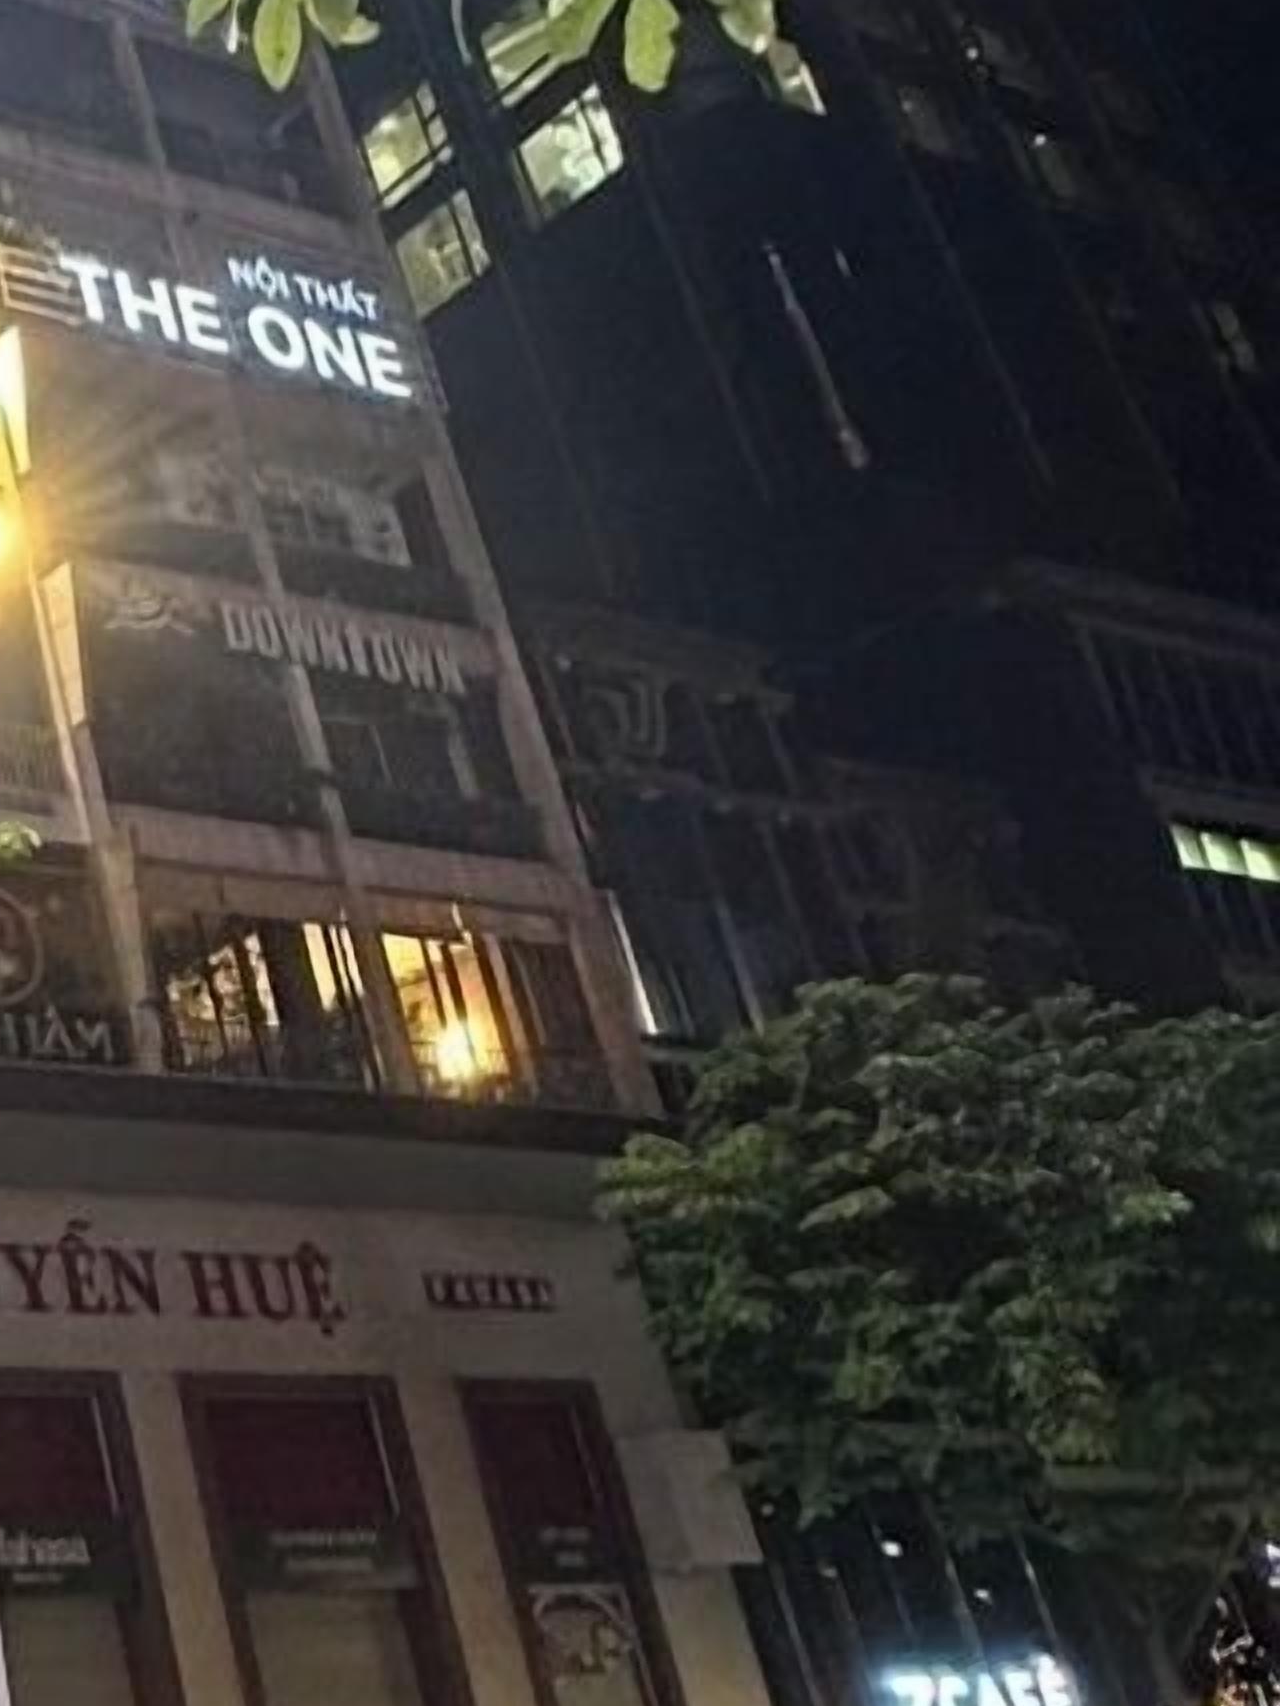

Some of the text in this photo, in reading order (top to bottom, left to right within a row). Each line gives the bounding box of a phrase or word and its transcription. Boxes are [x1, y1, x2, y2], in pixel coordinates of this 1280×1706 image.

[58, 251, 412, 398] THE ONE
[180, 1239, 346, 1338] HUỆ
